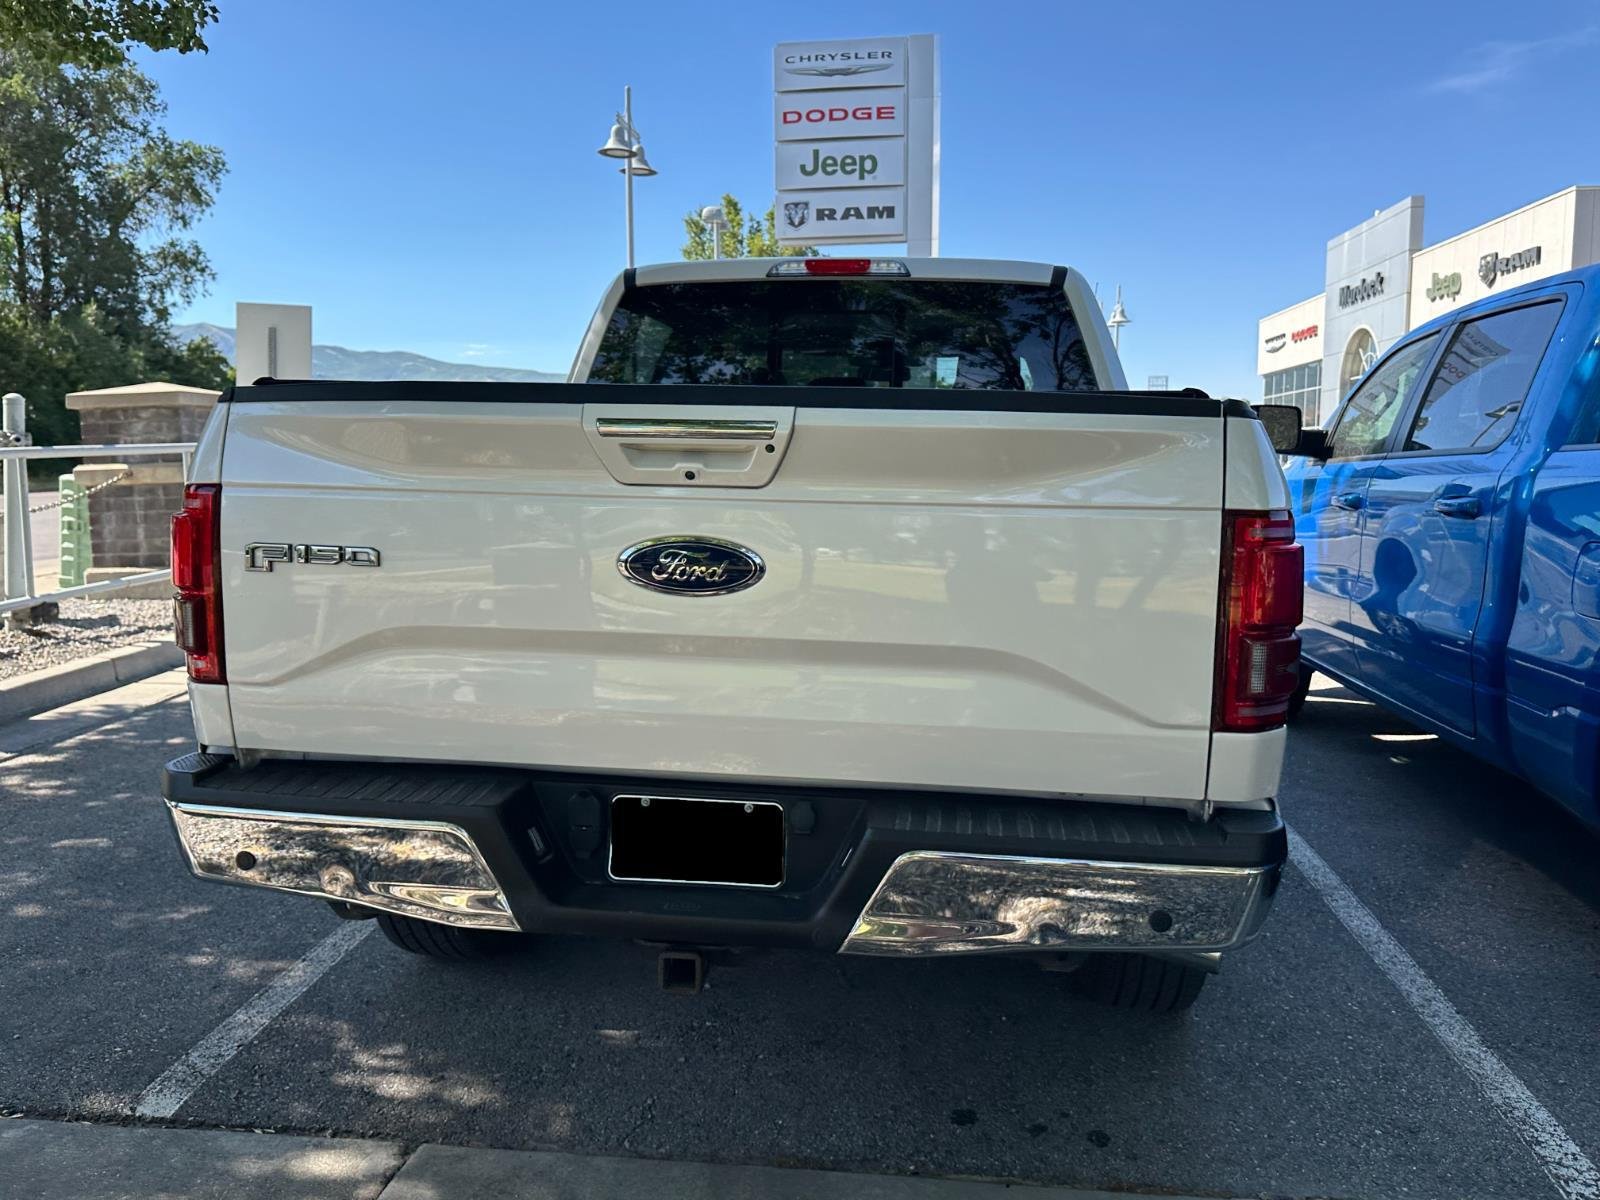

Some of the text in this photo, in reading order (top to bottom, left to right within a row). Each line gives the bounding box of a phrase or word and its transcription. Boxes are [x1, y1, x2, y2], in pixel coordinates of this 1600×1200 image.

[785, 51, 893, 64] CHRYSLER
[783, 106, 895, 124] DODGE
[800, 149, 878, 180] Jeep
[816, 206, 895, 221] RAM
[1495, 246, 1541, 276] RAM
[1426, 271, 1462, 302] Jeep
[245, 542, 381, 572] F150
[652, 549, 730, 582] Ford
